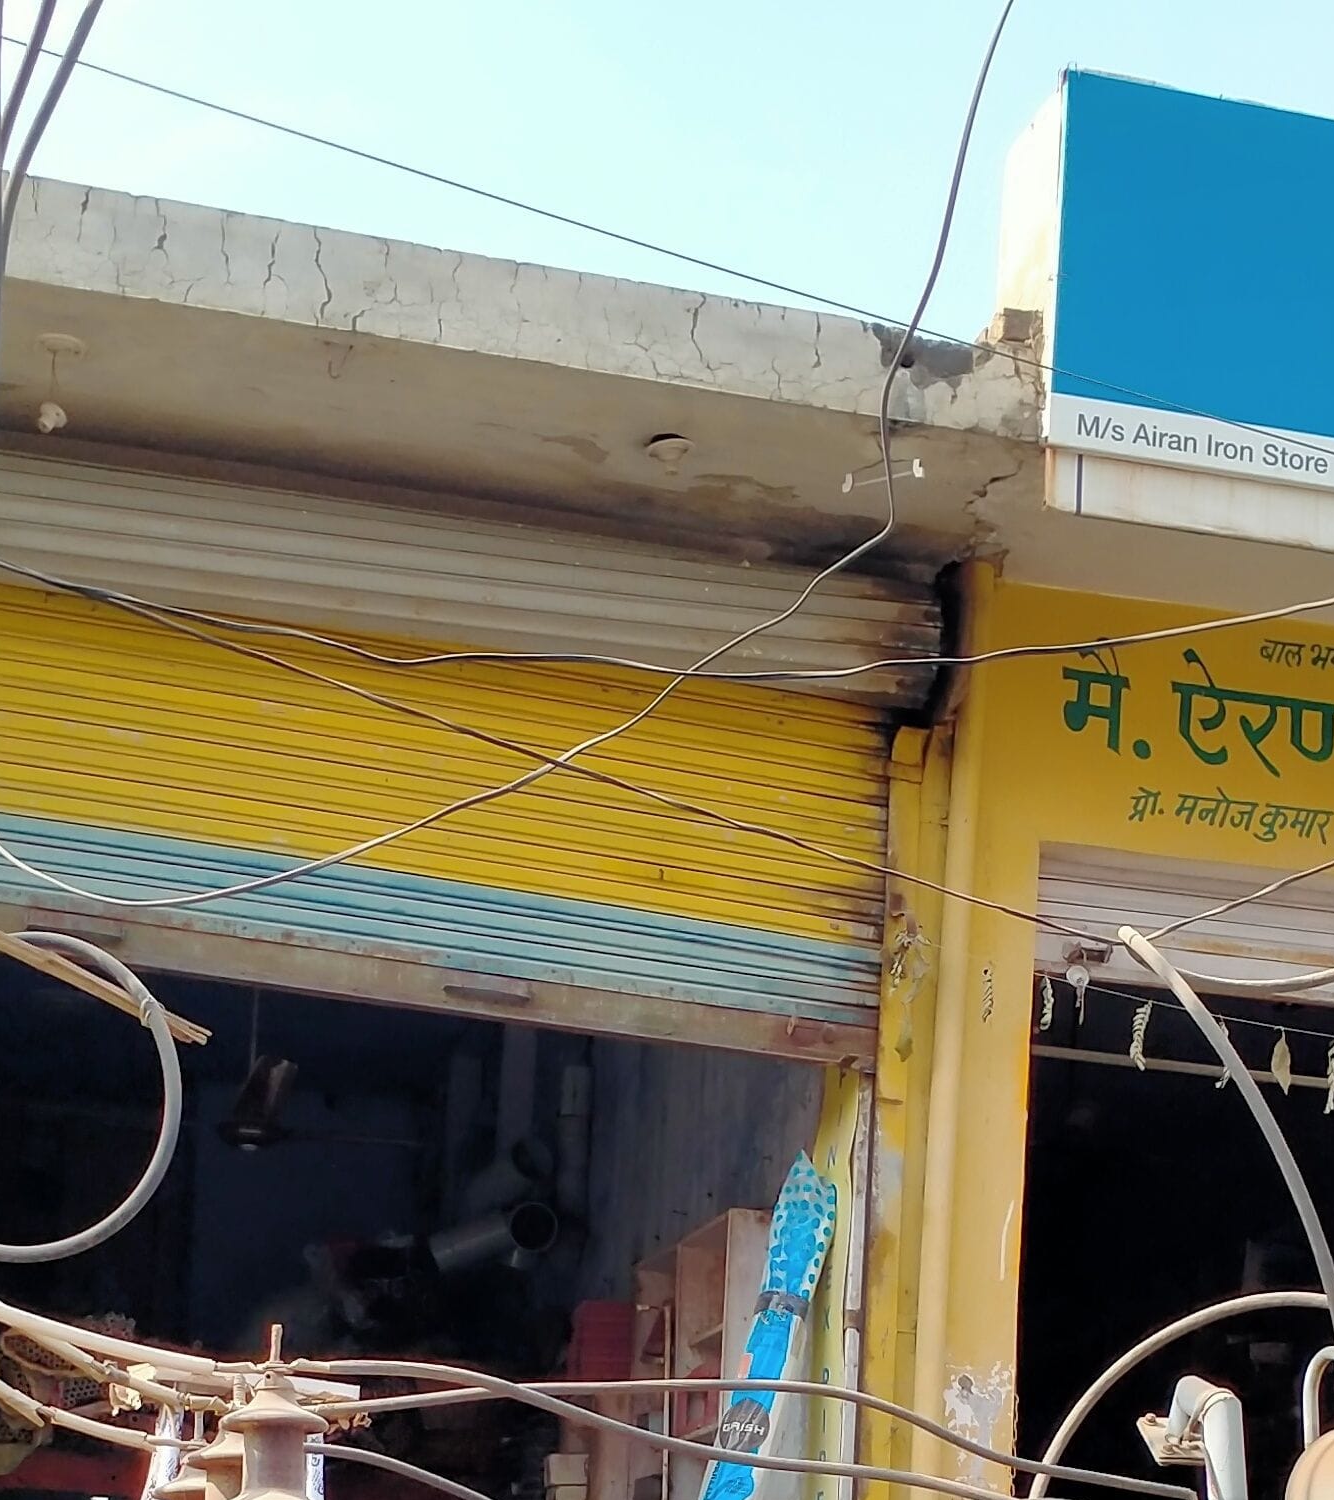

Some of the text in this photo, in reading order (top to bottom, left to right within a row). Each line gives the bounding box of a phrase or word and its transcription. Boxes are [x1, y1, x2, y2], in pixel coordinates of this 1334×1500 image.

[1077, 413, 1329, 474] M/s Airan Iron Store
